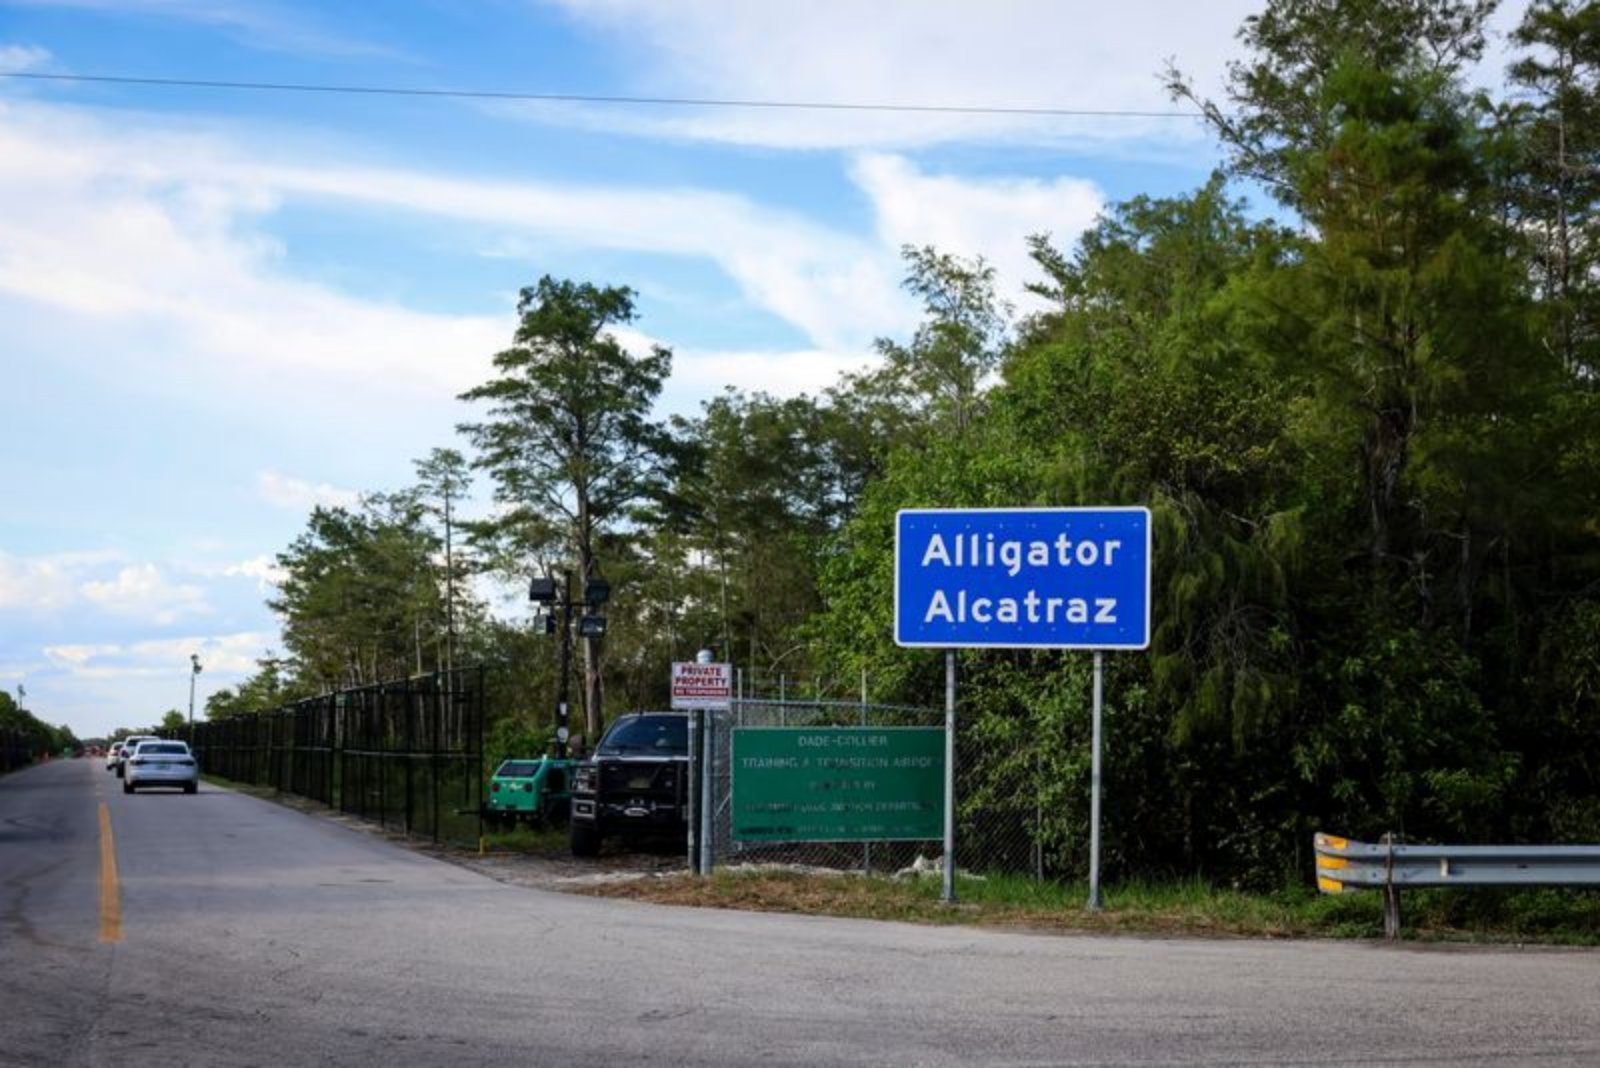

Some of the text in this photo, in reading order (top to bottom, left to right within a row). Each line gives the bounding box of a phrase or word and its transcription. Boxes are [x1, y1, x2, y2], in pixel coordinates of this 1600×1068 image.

[921, 533, 1121, 577] Alligator
[924, 589, 1118, 623] Alcatraz
[681, 665, 722, 676] PRIVATE
[675, 677, 728, 687] PROPERTY
[798, 735, 888, 747] DADE-COLLIER
[743, 756, 798, 768] TRAINING
